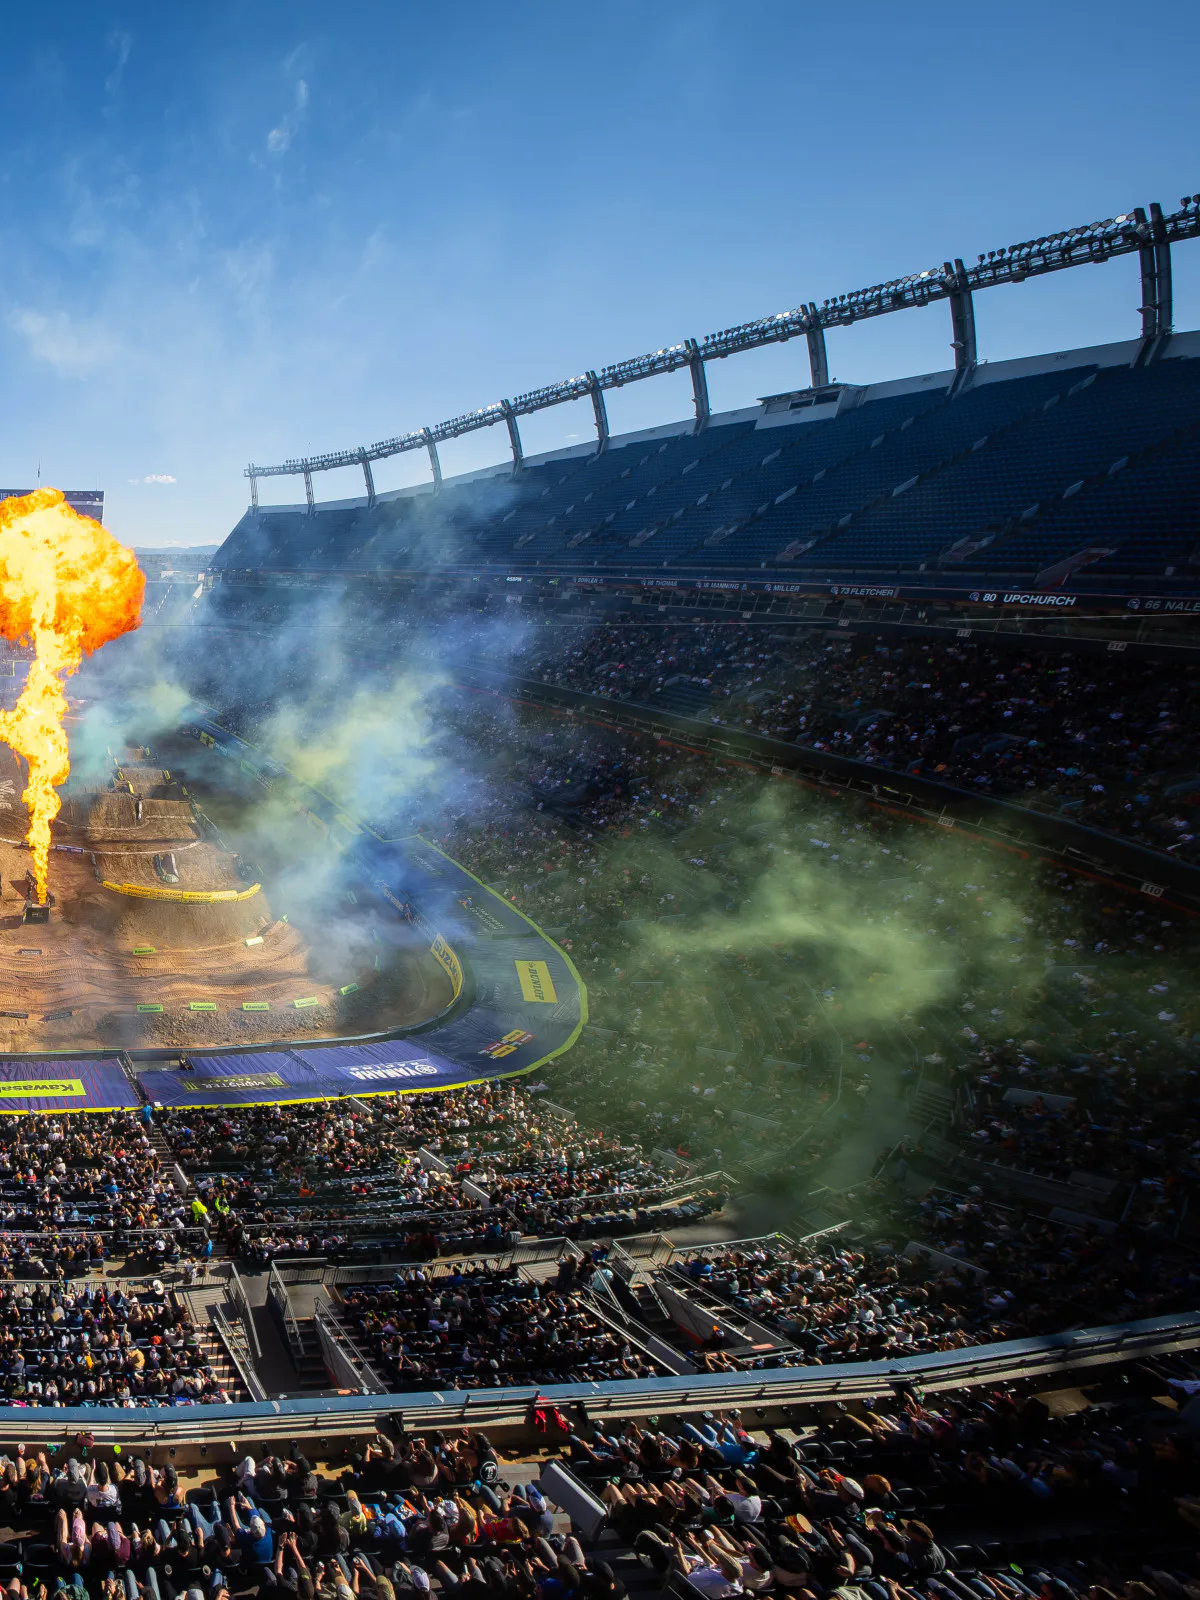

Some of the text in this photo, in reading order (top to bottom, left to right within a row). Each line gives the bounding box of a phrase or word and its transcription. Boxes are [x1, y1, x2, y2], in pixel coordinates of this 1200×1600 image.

[840, 587, 893, 597] 73 FLETCHER
[983, 593, 1076, 606] 80 UPCHURCH
[1145, 600, 1161, 610] 66
[1142, 883, 1162, 896] 110
[528, 968, 545, 1000] DUNLOP
[350, 1061, 419, 1071] RACING
[349, 1066, 418, 1080] YAMAHA
[202, 1080, 267, 1089] MONSTER
